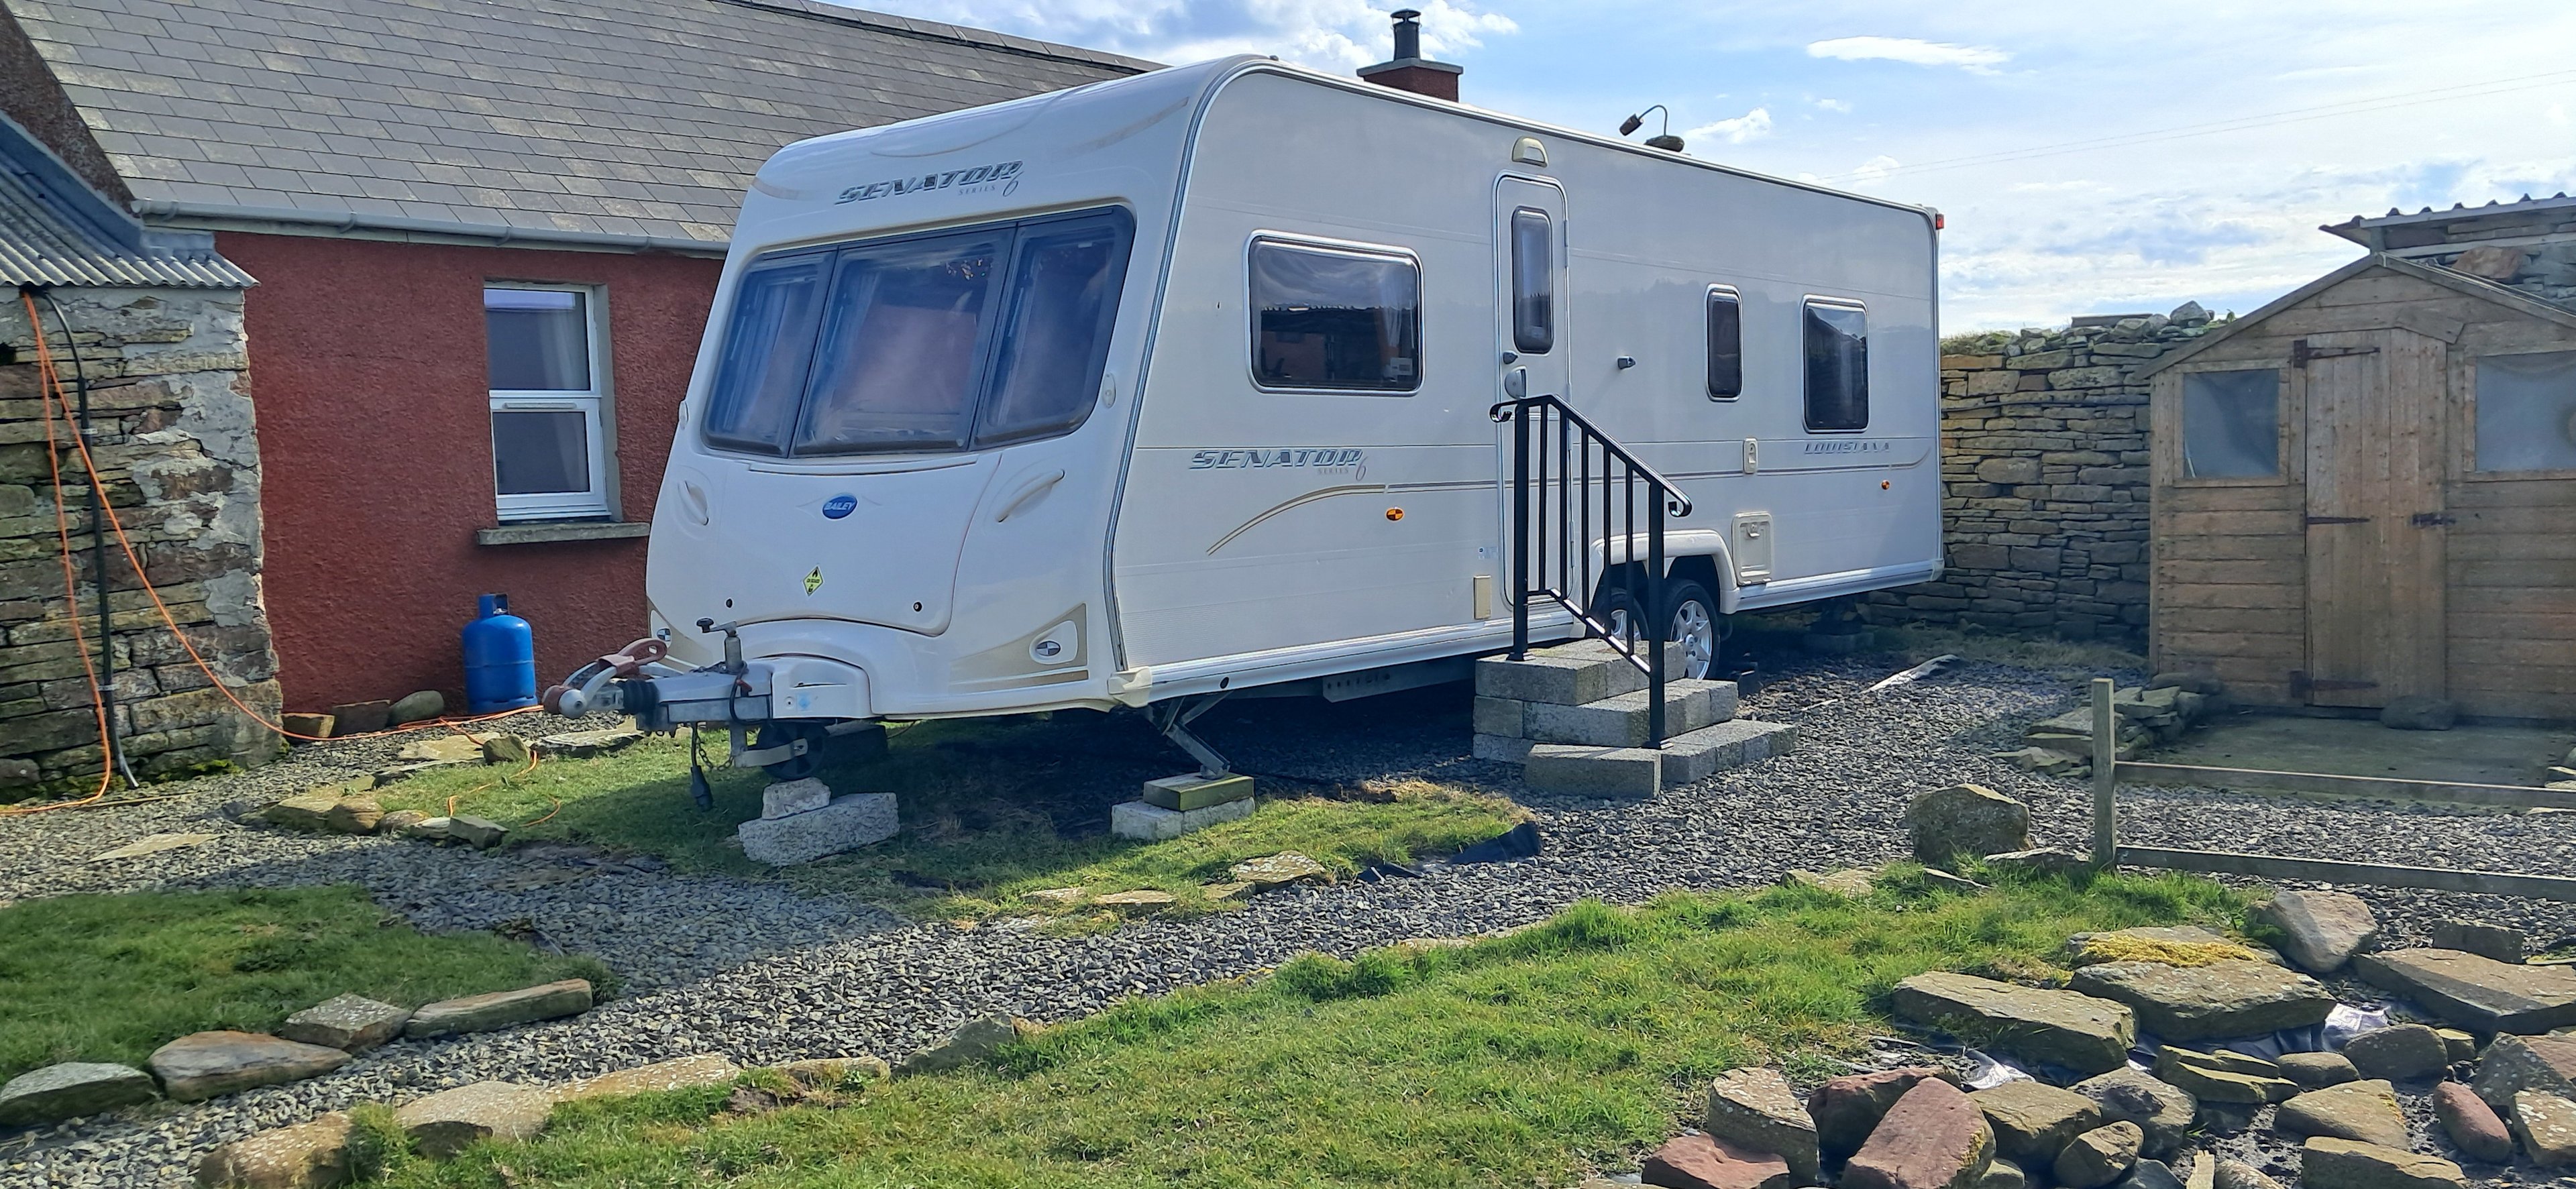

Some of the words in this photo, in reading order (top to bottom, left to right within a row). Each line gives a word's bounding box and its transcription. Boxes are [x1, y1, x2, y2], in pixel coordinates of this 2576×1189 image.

[835, 160, 1023, 205] SENATOR
[958, 184, 996, 196] SERIES
[1003, 170, 1025, 197] 6
[1189, 449, 1364, 469] SENATOR
[1804, 441, 1890, 455] LOUISIANA
[1355, 456, 1369, 482] 6
[824, 502, 856, 510] BAILEY
